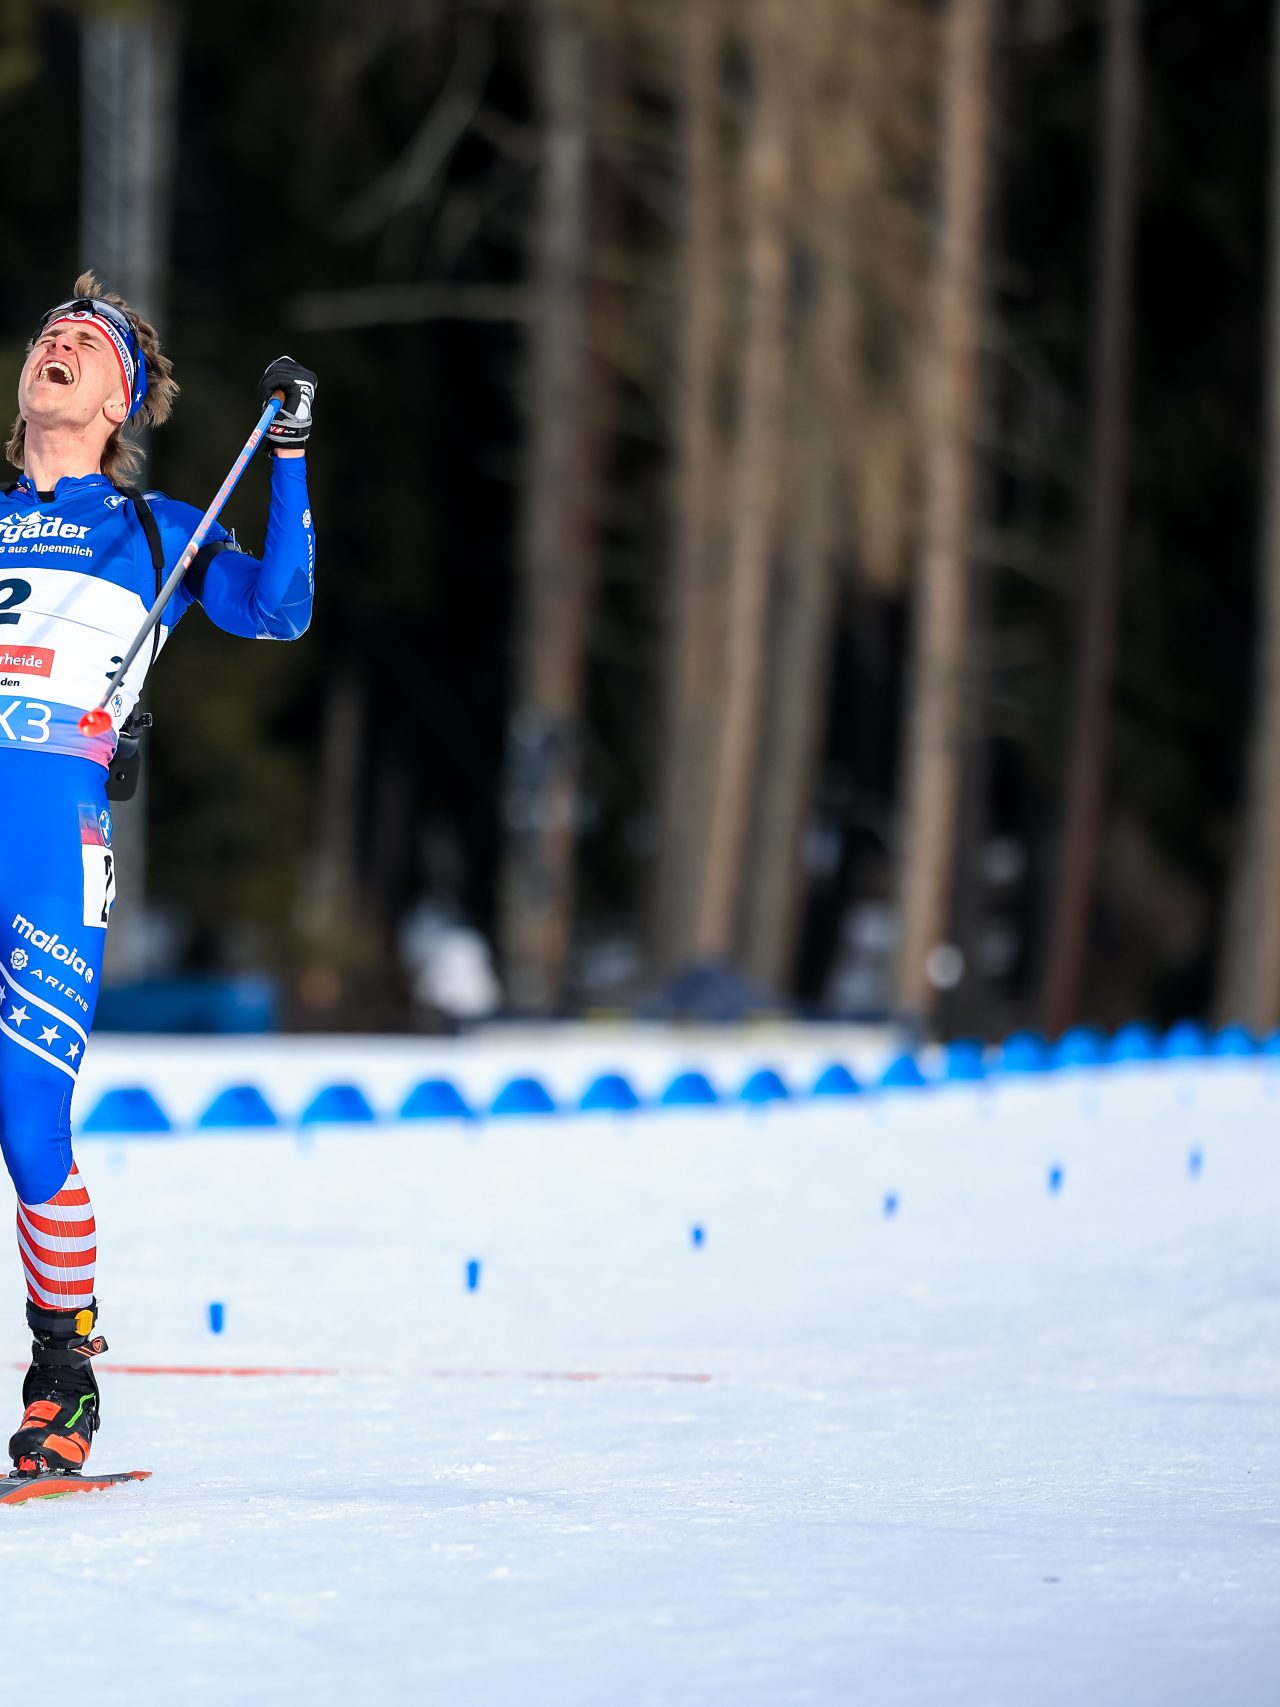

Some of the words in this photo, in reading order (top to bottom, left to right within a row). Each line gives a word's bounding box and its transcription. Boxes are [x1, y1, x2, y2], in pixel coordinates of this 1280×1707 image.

[7, 546, 28, 554] aus
[30, 543, 93, 558] Alpenmilch
[12, 913, 87, 976] maloja
[29, 969, 89, 1013] ARIENS
